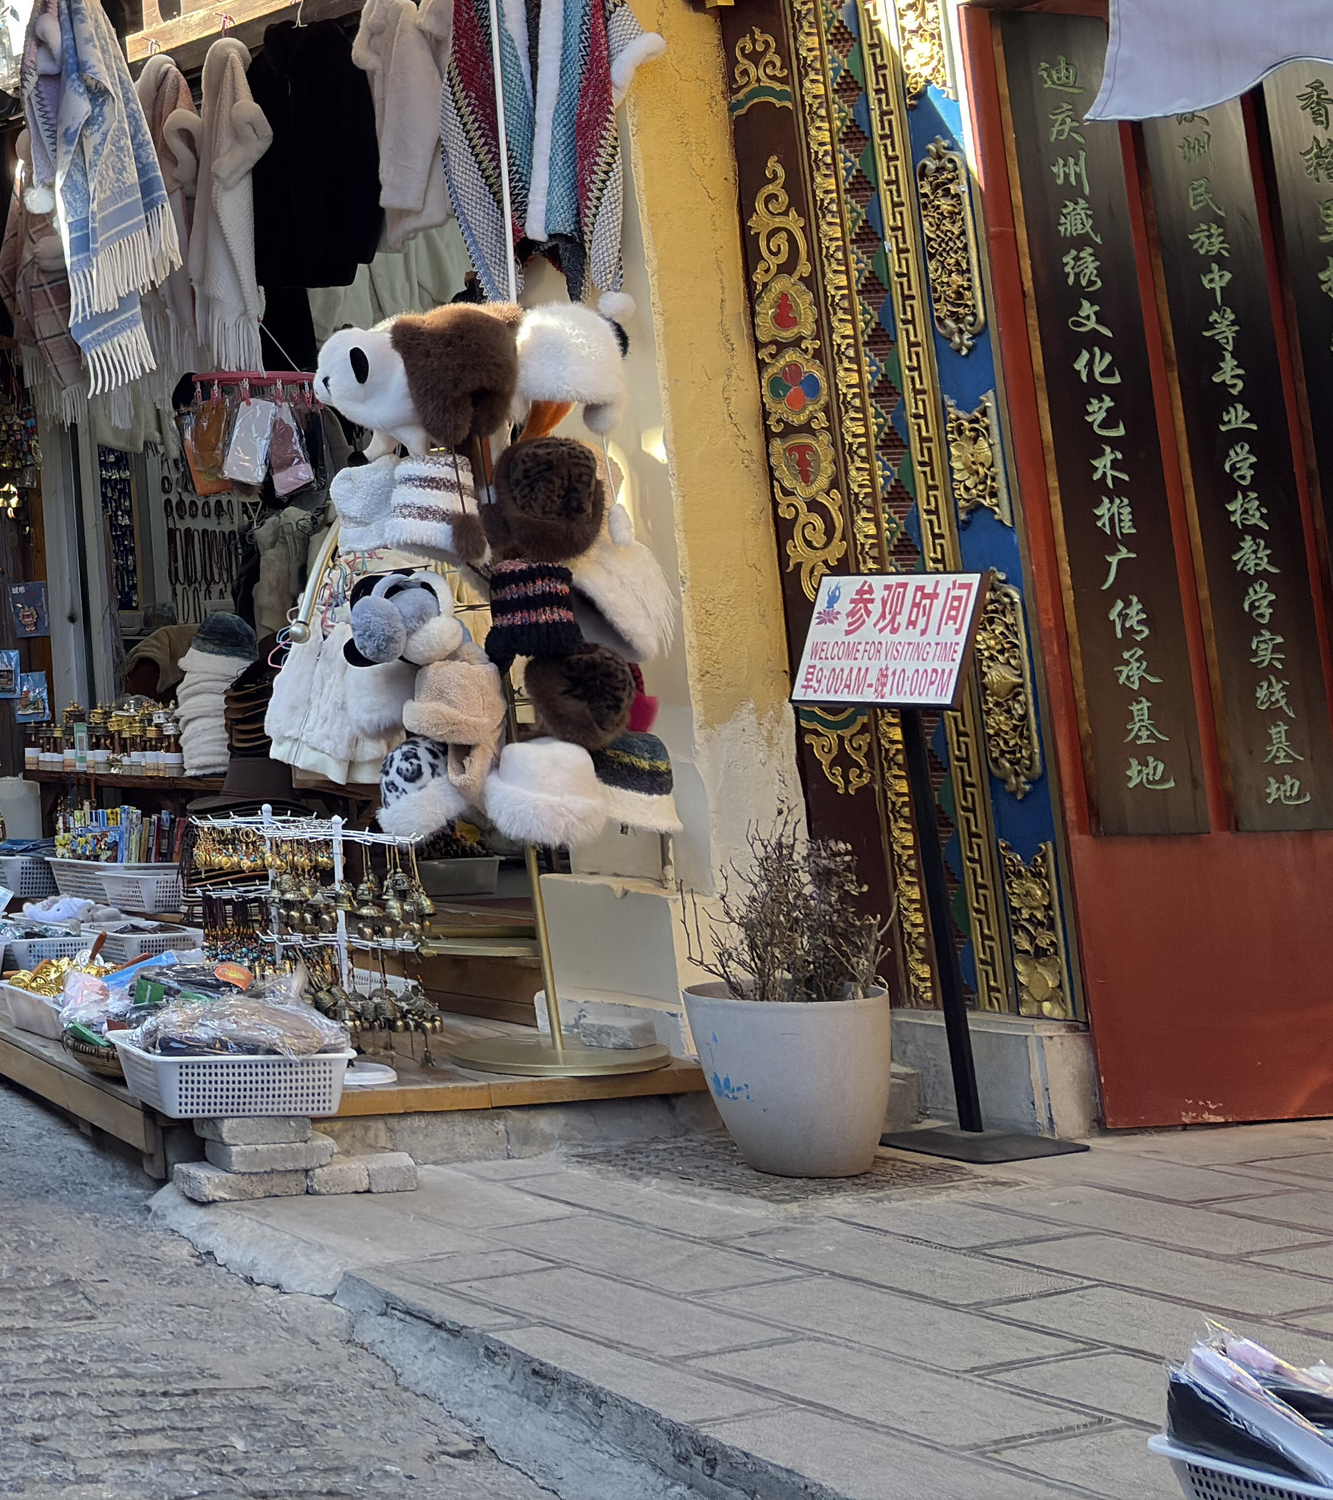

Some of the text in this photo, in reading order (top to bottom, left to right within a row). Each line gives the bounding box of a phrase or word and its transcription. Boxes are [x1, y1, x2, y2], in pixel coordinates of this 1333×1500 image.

[1037, 55, 1175, 790] 迪庆州藏绣文化艺术推广传承基地
[844, 579, 974, 637] 参观时间
[809, 641, 960, 663] WELCOME FOR VISITING TIME
